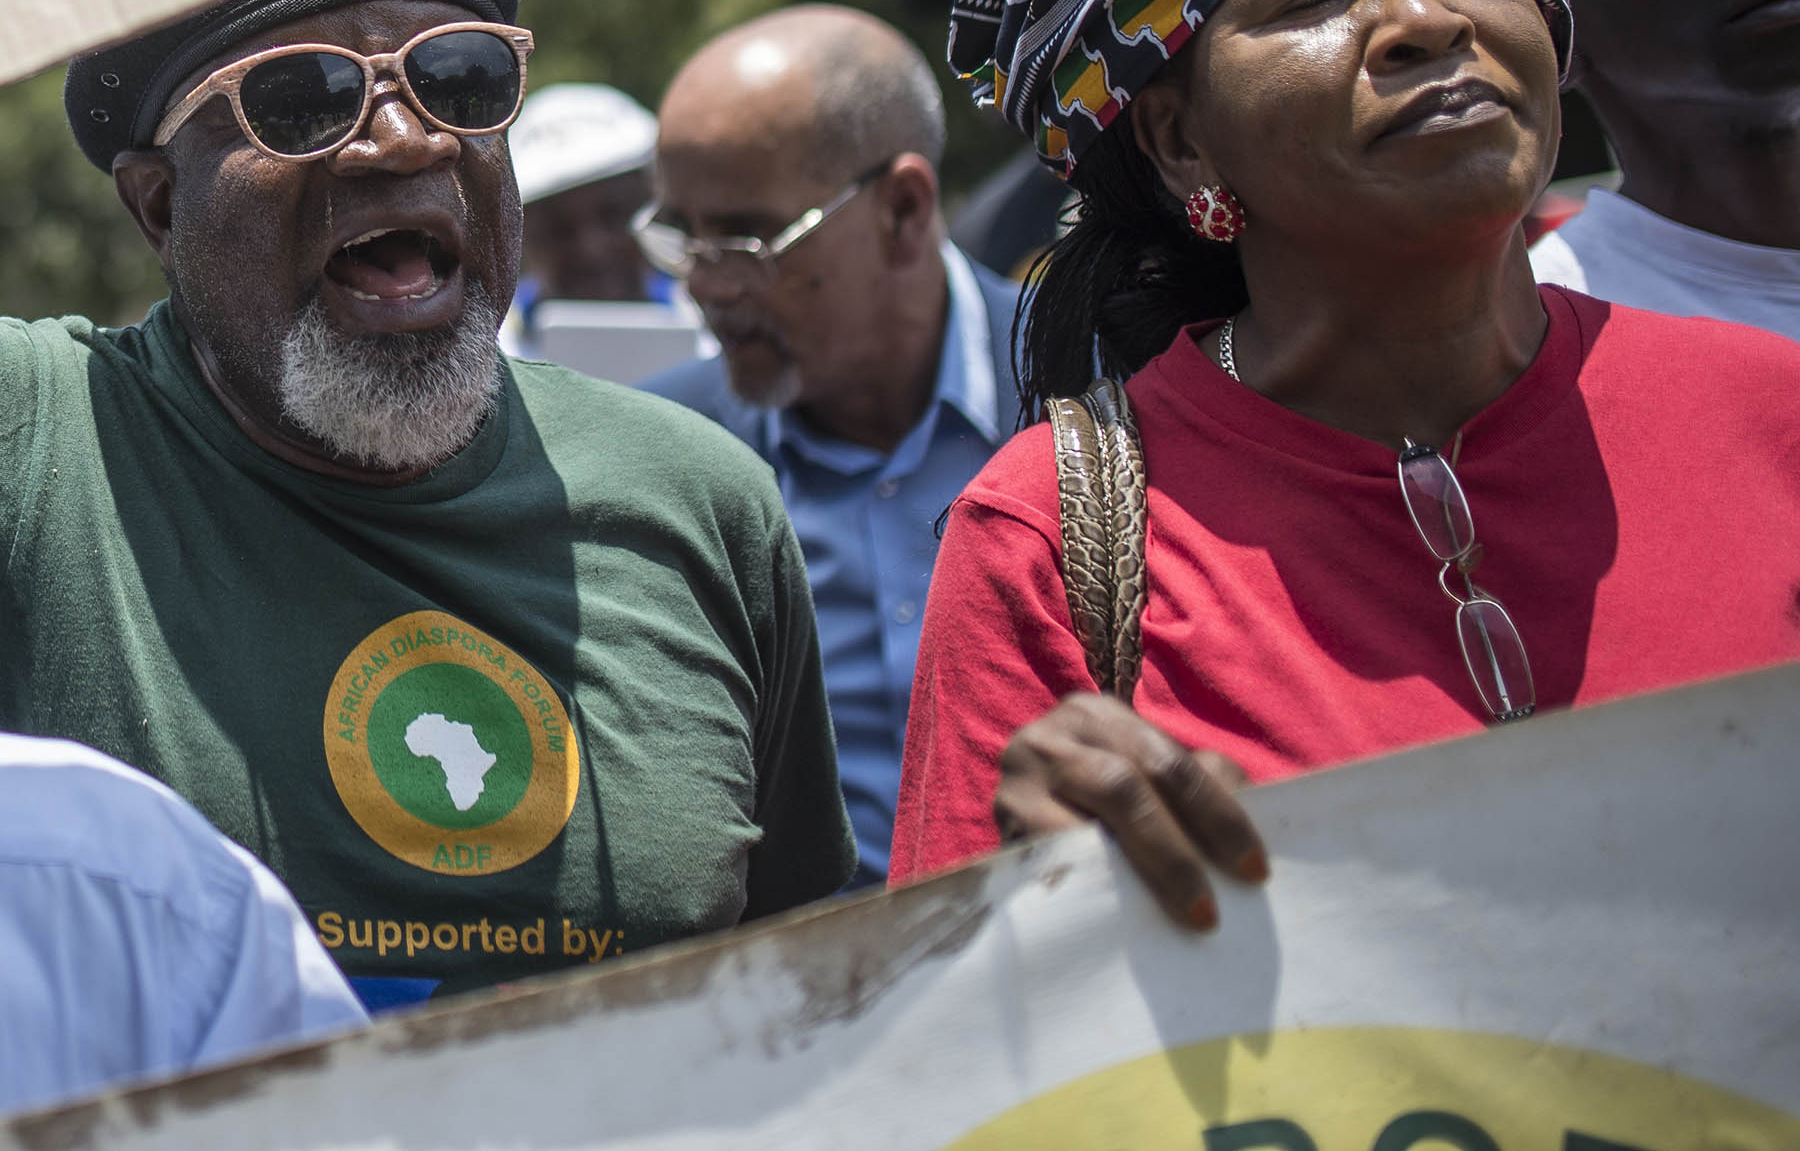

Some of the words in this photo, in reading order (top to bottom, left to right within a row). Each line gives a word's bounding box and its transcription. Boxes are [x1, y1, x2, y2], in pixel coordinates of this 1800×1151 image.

[339, 650, 390, 744] AFRICAN
[390, 626, 506, 672] DIASPORA
[511, 668, 566, 754] FORUM
[432, 843, 493, 870] ADF
[317, 911, 546, 957] Supported
[563, 920, 625, 963] by:
